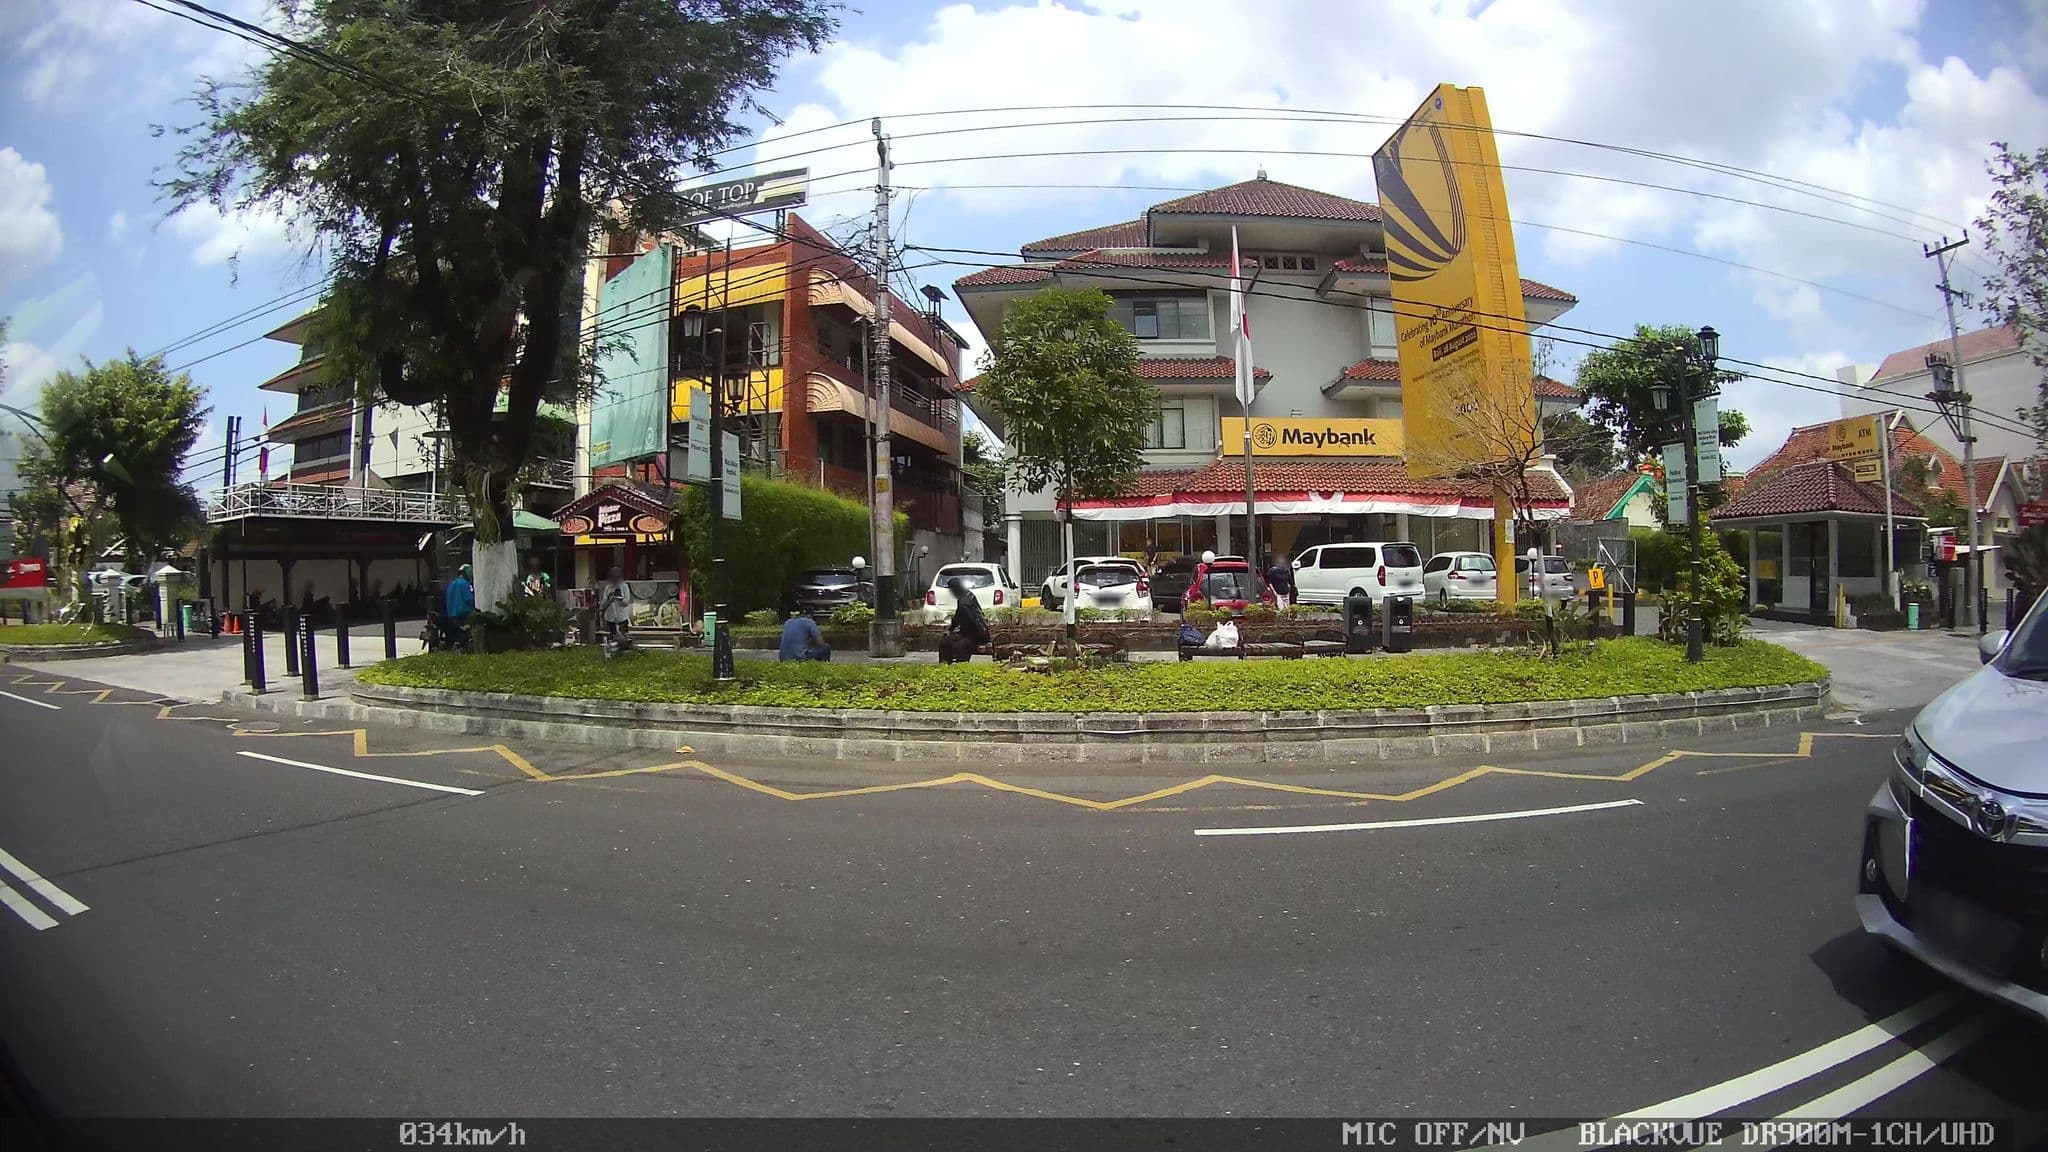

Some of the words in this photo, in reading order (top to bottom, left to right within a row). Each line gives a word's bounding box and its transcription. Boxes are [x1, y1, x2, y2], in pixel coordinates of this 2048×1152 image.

[718, 182, 755, 204] TOP
[1400, 320, 1430, 343] Celebrating
[1419, 336, 1426, 349] of
[1426, 325, 1449, 345] Maybank
[1282, 428, 1377, 448] Maybank
[1858, 429, 1873, 439] ATM
[1832, 442, 1855, 453] Maybank
[598, 511, 622, 527] Pizza
[1592, 571, 1599, 584] P
